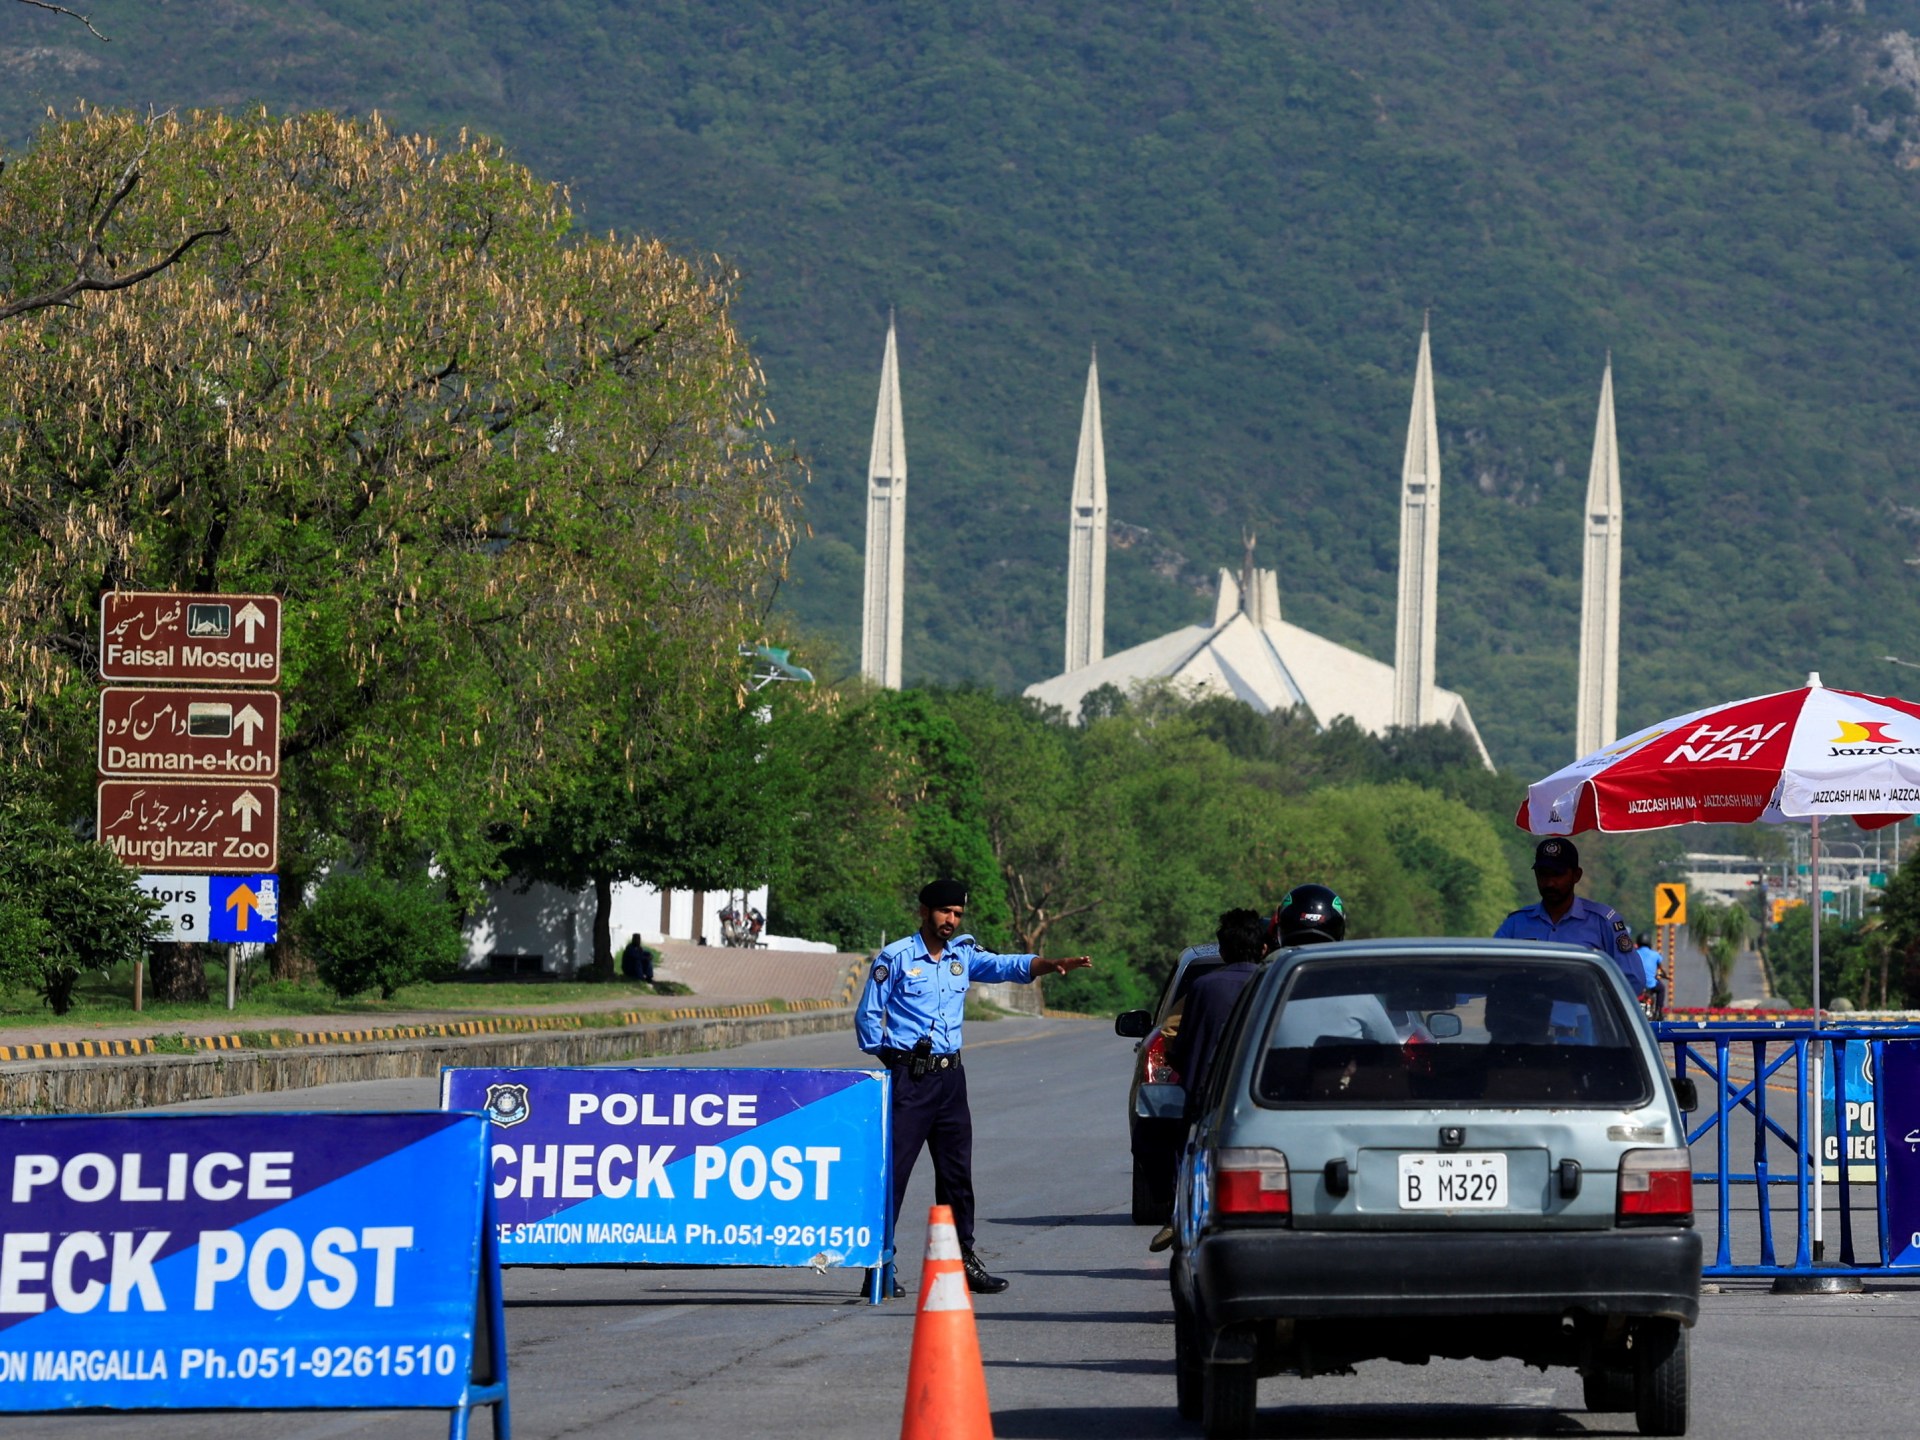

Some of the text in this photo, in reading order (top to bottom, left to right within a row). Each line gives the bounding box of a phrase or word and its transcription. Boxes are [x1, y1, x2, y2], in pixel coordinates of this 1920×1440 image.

[107, 601, 181, 642] فیصل مسجد
[107, 644, 274, 673] Faisal Mosque
[132, 703, 187, 741] دامن
[1685, 722, 1787, 743] HAI
[107, 746, 271, 772] Daman-e-koh
[1663, 742, 1765, 763] NA!
[1628, 797, 1668, 814] JAZZCASH
[1670, 796, 1684, 810] HAI
[1686, 796, 1697, 808] NA
[1703, 794, 1740, 808] JAZZCASH
[1811, 790, 1850, 804] JAZZCASH
[1853, 789, 1867, 802] HAI
[1869, 789, 1880, 801] NA
[170, 799, 224, 832] مرغزار
[106, 835, 270, 861] Murghzar Zoo
[568, 1093, 758, 1126] POLICE
[12, 1152, 294, 1202] POLICE
[491, 1143, 841, 1200] CHECK POST
[1408, 1174, 1498, 1202] B M329
[515, 1223, 582, 1243] STATION
[586, 1223, 677, 1244] MARGALLA
[685, 1223, 871, 1247] Ph.051-9261510
[194, 1226, 414, 1311] POST
[33, 1349, 168, 1382] MARGALLA
[180, 1344, 455, 1379] Ph.051-9261510
